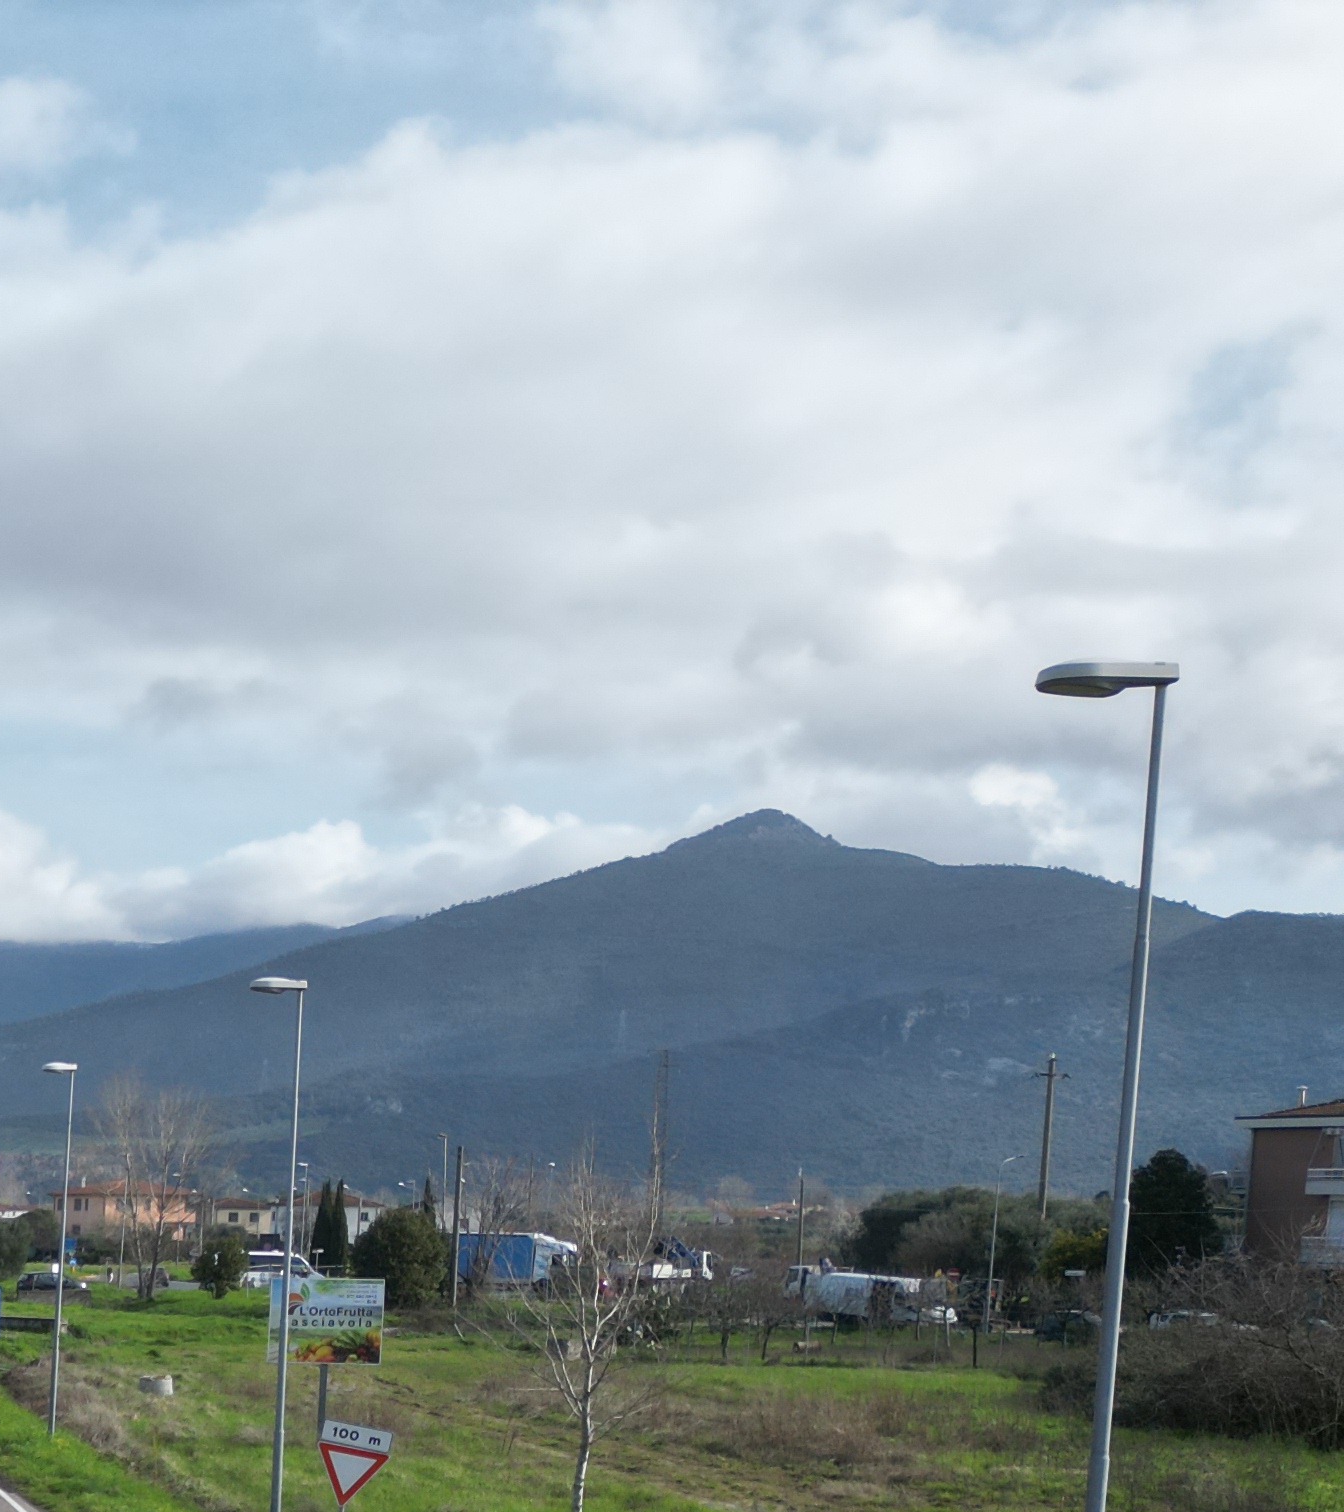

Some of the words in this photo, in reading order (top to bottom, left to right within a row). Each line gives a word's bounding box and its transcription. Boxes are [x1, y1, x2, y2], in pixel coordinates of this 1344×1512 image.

[300, 1306, 372, 1316] L'OrtoFrutta
[291, 1318, 373, 1328] asciavola
[333, 1427, 359, 1441] 100
[369, 1437, 381, 1446] m
